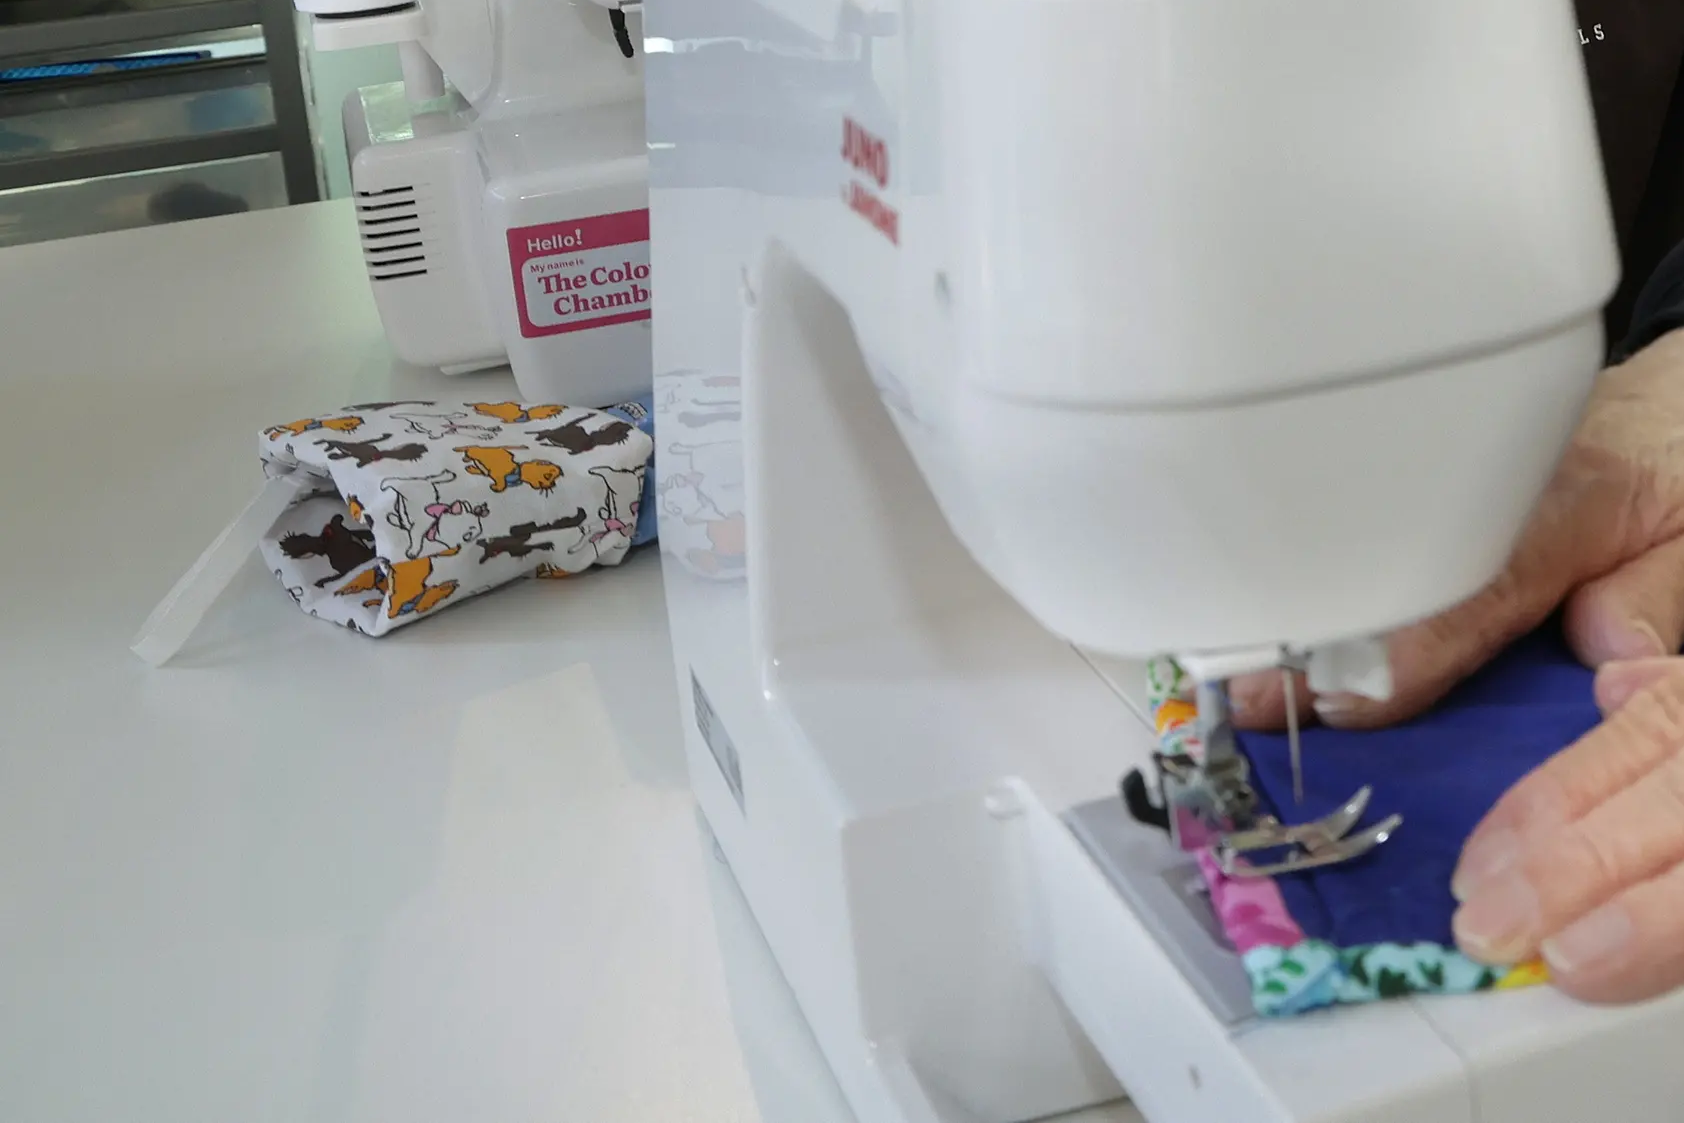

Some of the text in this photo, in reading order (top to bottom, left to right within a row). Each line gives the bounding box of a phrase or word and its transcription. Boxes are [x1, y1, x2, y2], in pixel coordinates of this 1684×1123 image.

[527, 228, 583, 253] Hello!
[530, 264, 546, 274] My
[547, 261, 575, 271] name
[537, 261, 651, 295] The Colo
[553, 284, 651, 316] Chamb
